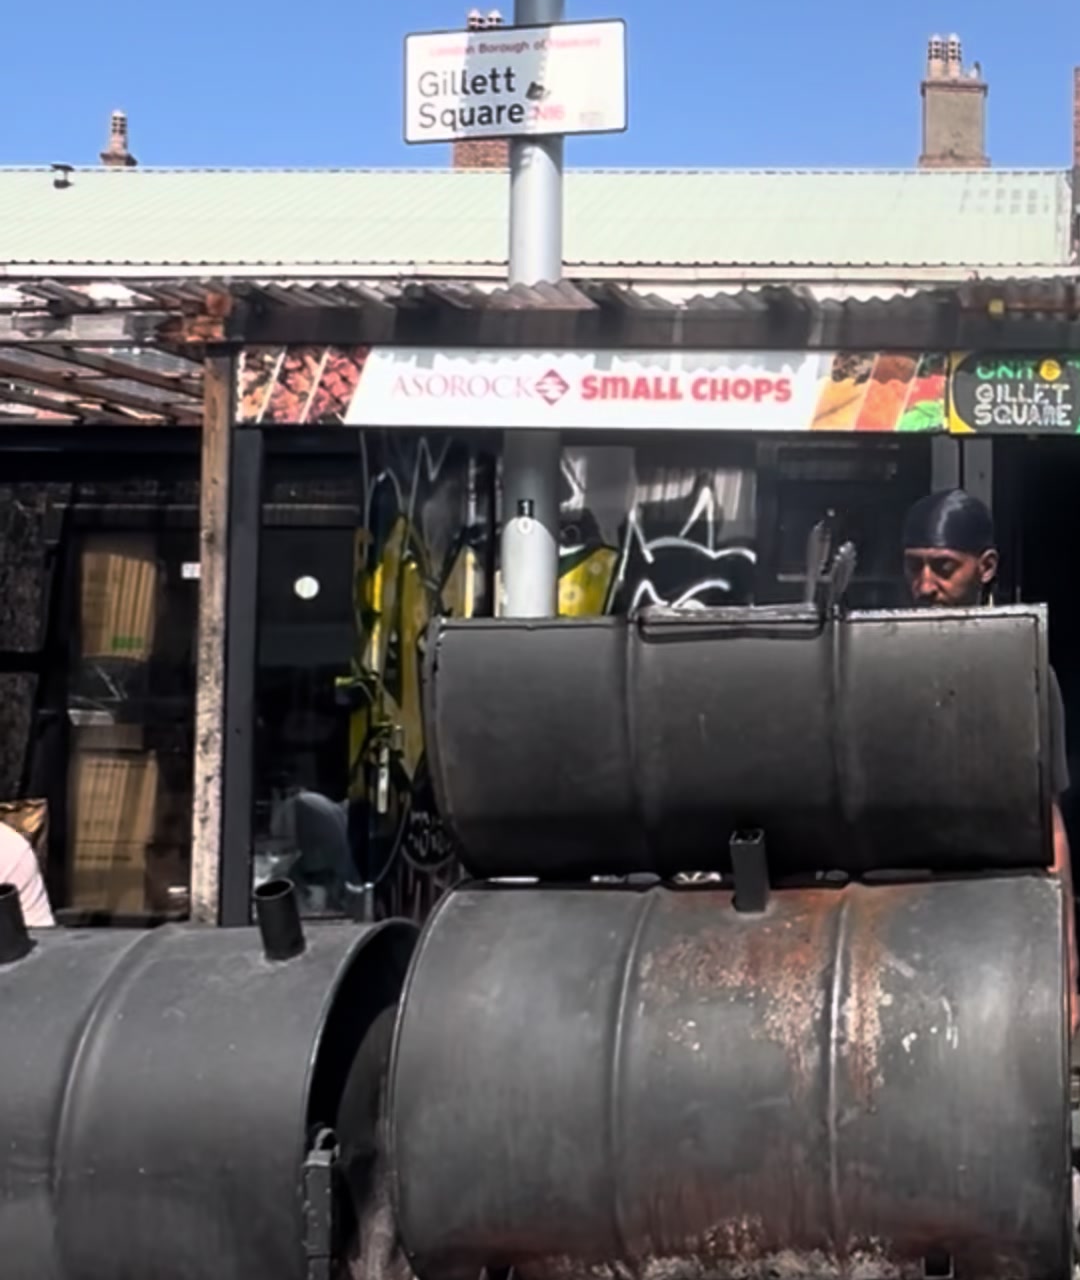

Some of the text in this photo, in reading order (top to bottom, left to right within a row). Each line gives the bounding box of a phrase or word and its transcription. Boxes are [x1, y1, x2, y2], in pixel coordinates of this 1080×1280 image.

[478, 38, 530, 55] Borough
[417, 65, 516, 98] Gillett
[418, 103, 525, 132] Square
[392, 375, 792, 403] ASOROCK SMALL CHOPS
[975, 383, 1071, 403] GILLET
[974, 404, 1073, 426] SQUARE
